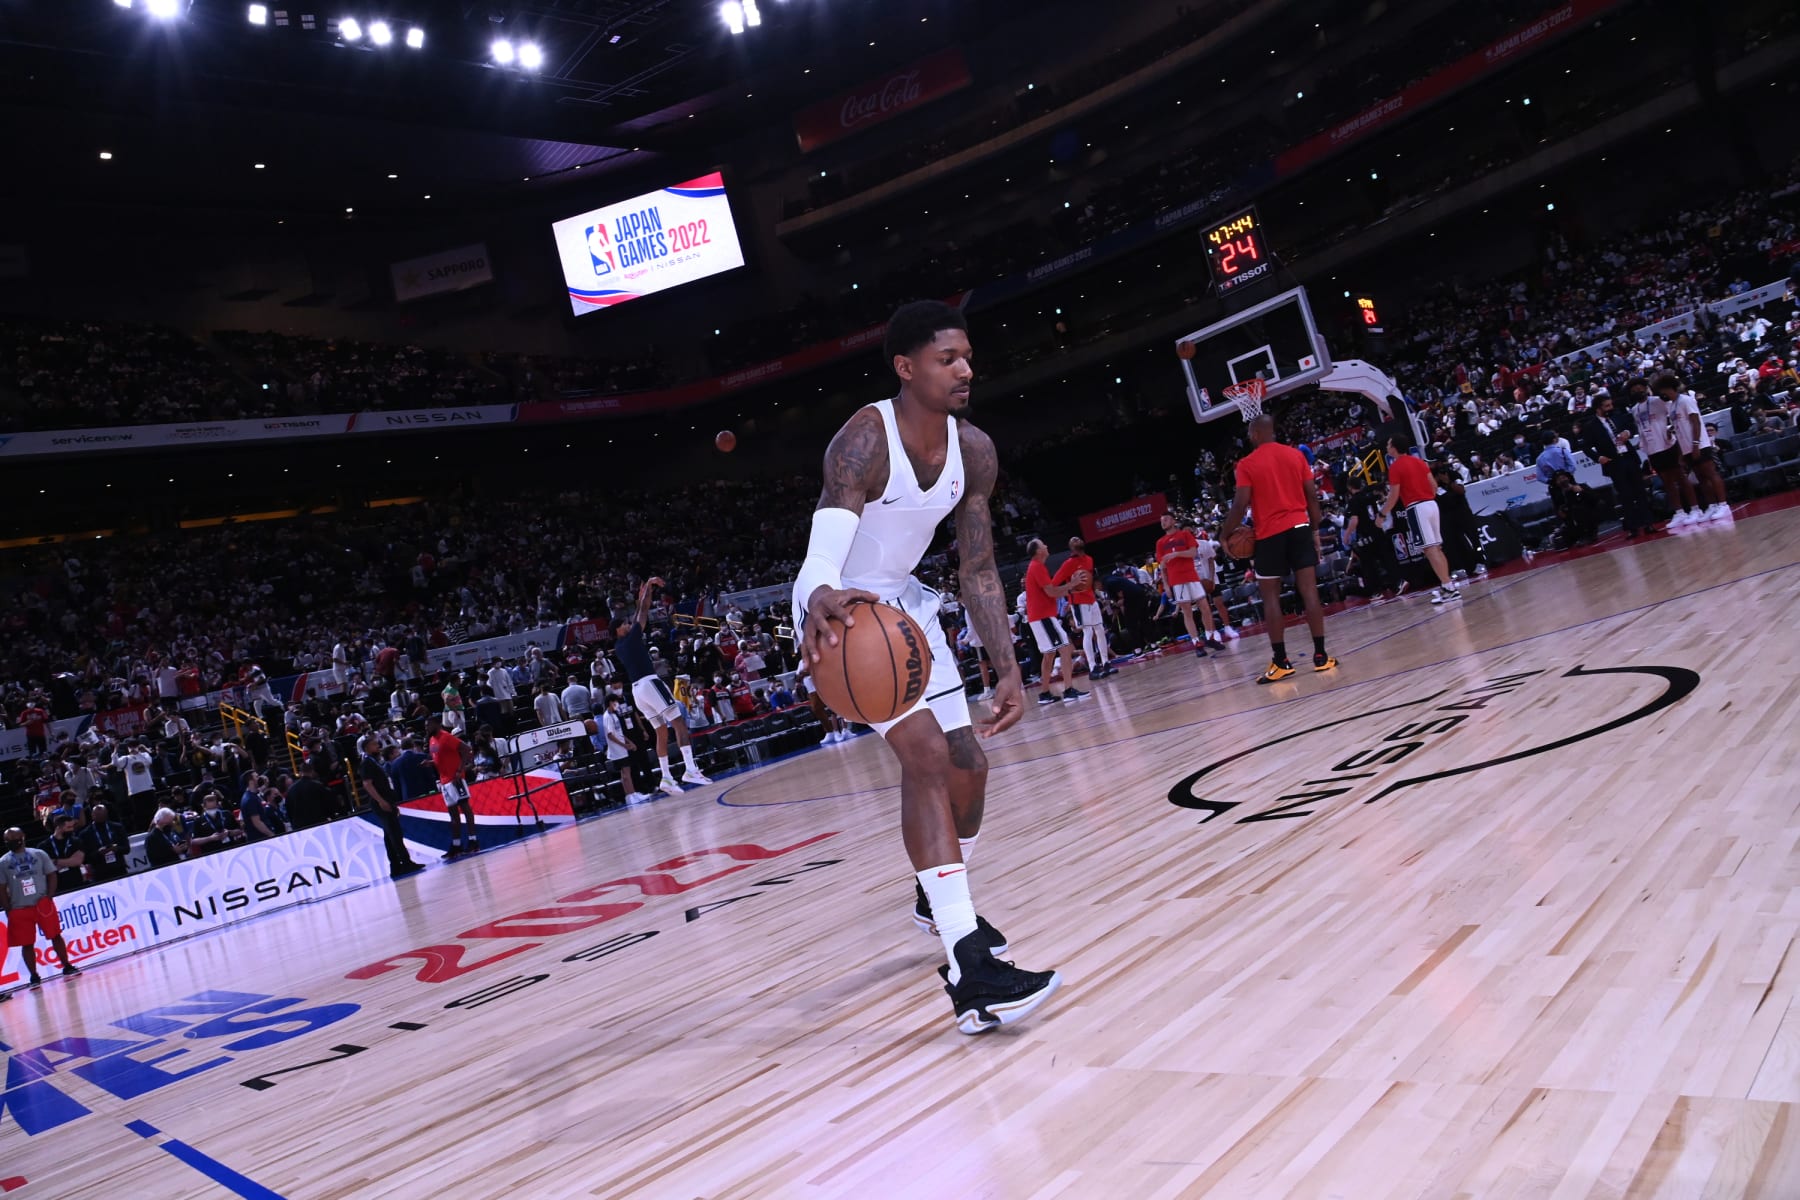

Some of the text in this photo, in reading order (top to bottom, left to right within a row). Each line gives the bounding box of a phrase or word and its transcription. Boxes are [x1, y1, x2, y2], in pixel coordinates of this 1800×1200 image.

[1547, 6, 1573, 28] 2022
[614, 206, 663, 243] JAPAN
[1208, 215, 1254, 245] 47:44
[617, 218, 711, 269] GAMES 2022
[1219, 235, 1258, 275] 24
[427, 258, 485, 281] SAPPORO
[656, 252, 701, 270] NISSAN
[1231, 262, 1269, 286] TISSOT
[279, 420, 321, 429] TISSOT
[386, 410, 483, 425] NISSAN
[52, 433, 133, 446] servicenow
[897, 619, 923, 705] Wilson
[546, 726, 572, 737] Wilson
[1235, 669, 1545, 824] NISSAN
[173, 861, 341, 925] NISSAN
[98, 894, 118, 921] by
[344, 831, 838, 984] 2022
[239, 858, 843, 1091] NISSAN
